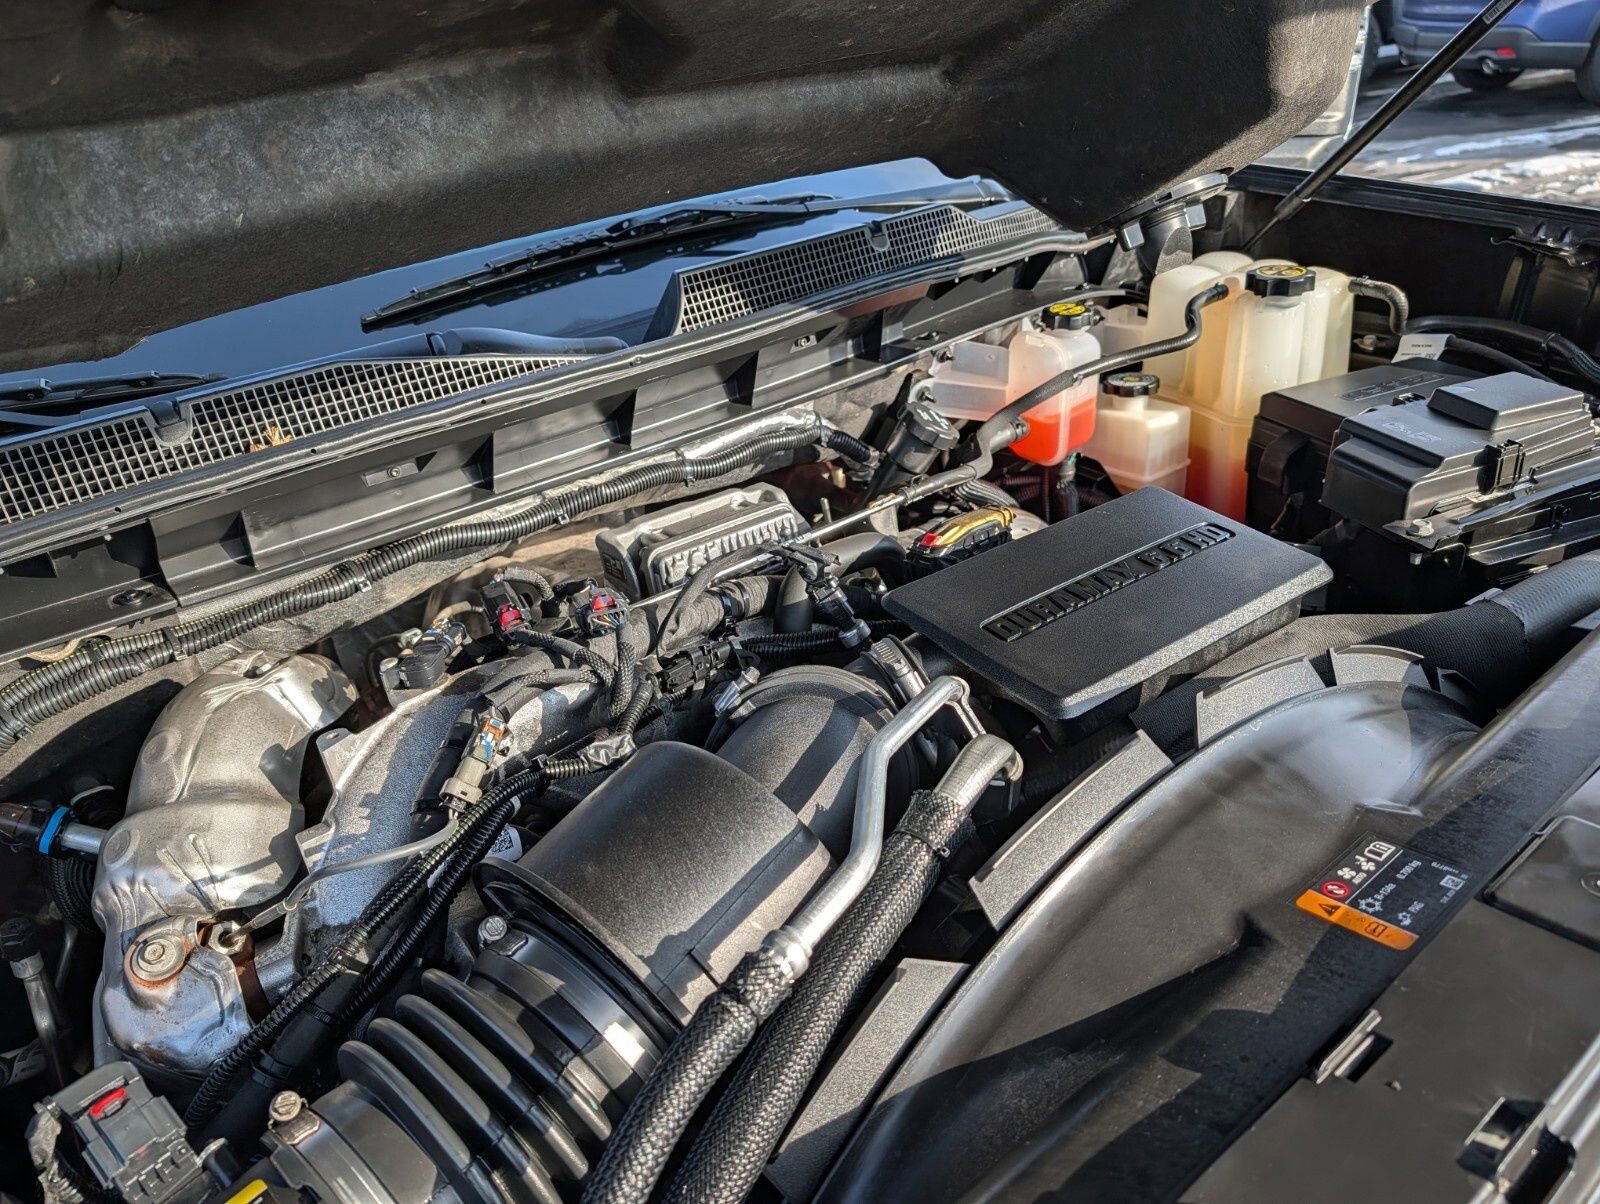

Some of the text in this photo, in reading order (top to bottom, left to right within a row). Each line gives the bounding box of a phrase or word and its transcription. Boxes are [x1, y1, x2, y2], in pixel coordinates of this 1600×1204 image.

[982, 560, 1148, 642] DURAMAX
[1182, 526, 1231, 550] HD
[1373, 883, 1396, 900] R-134a
